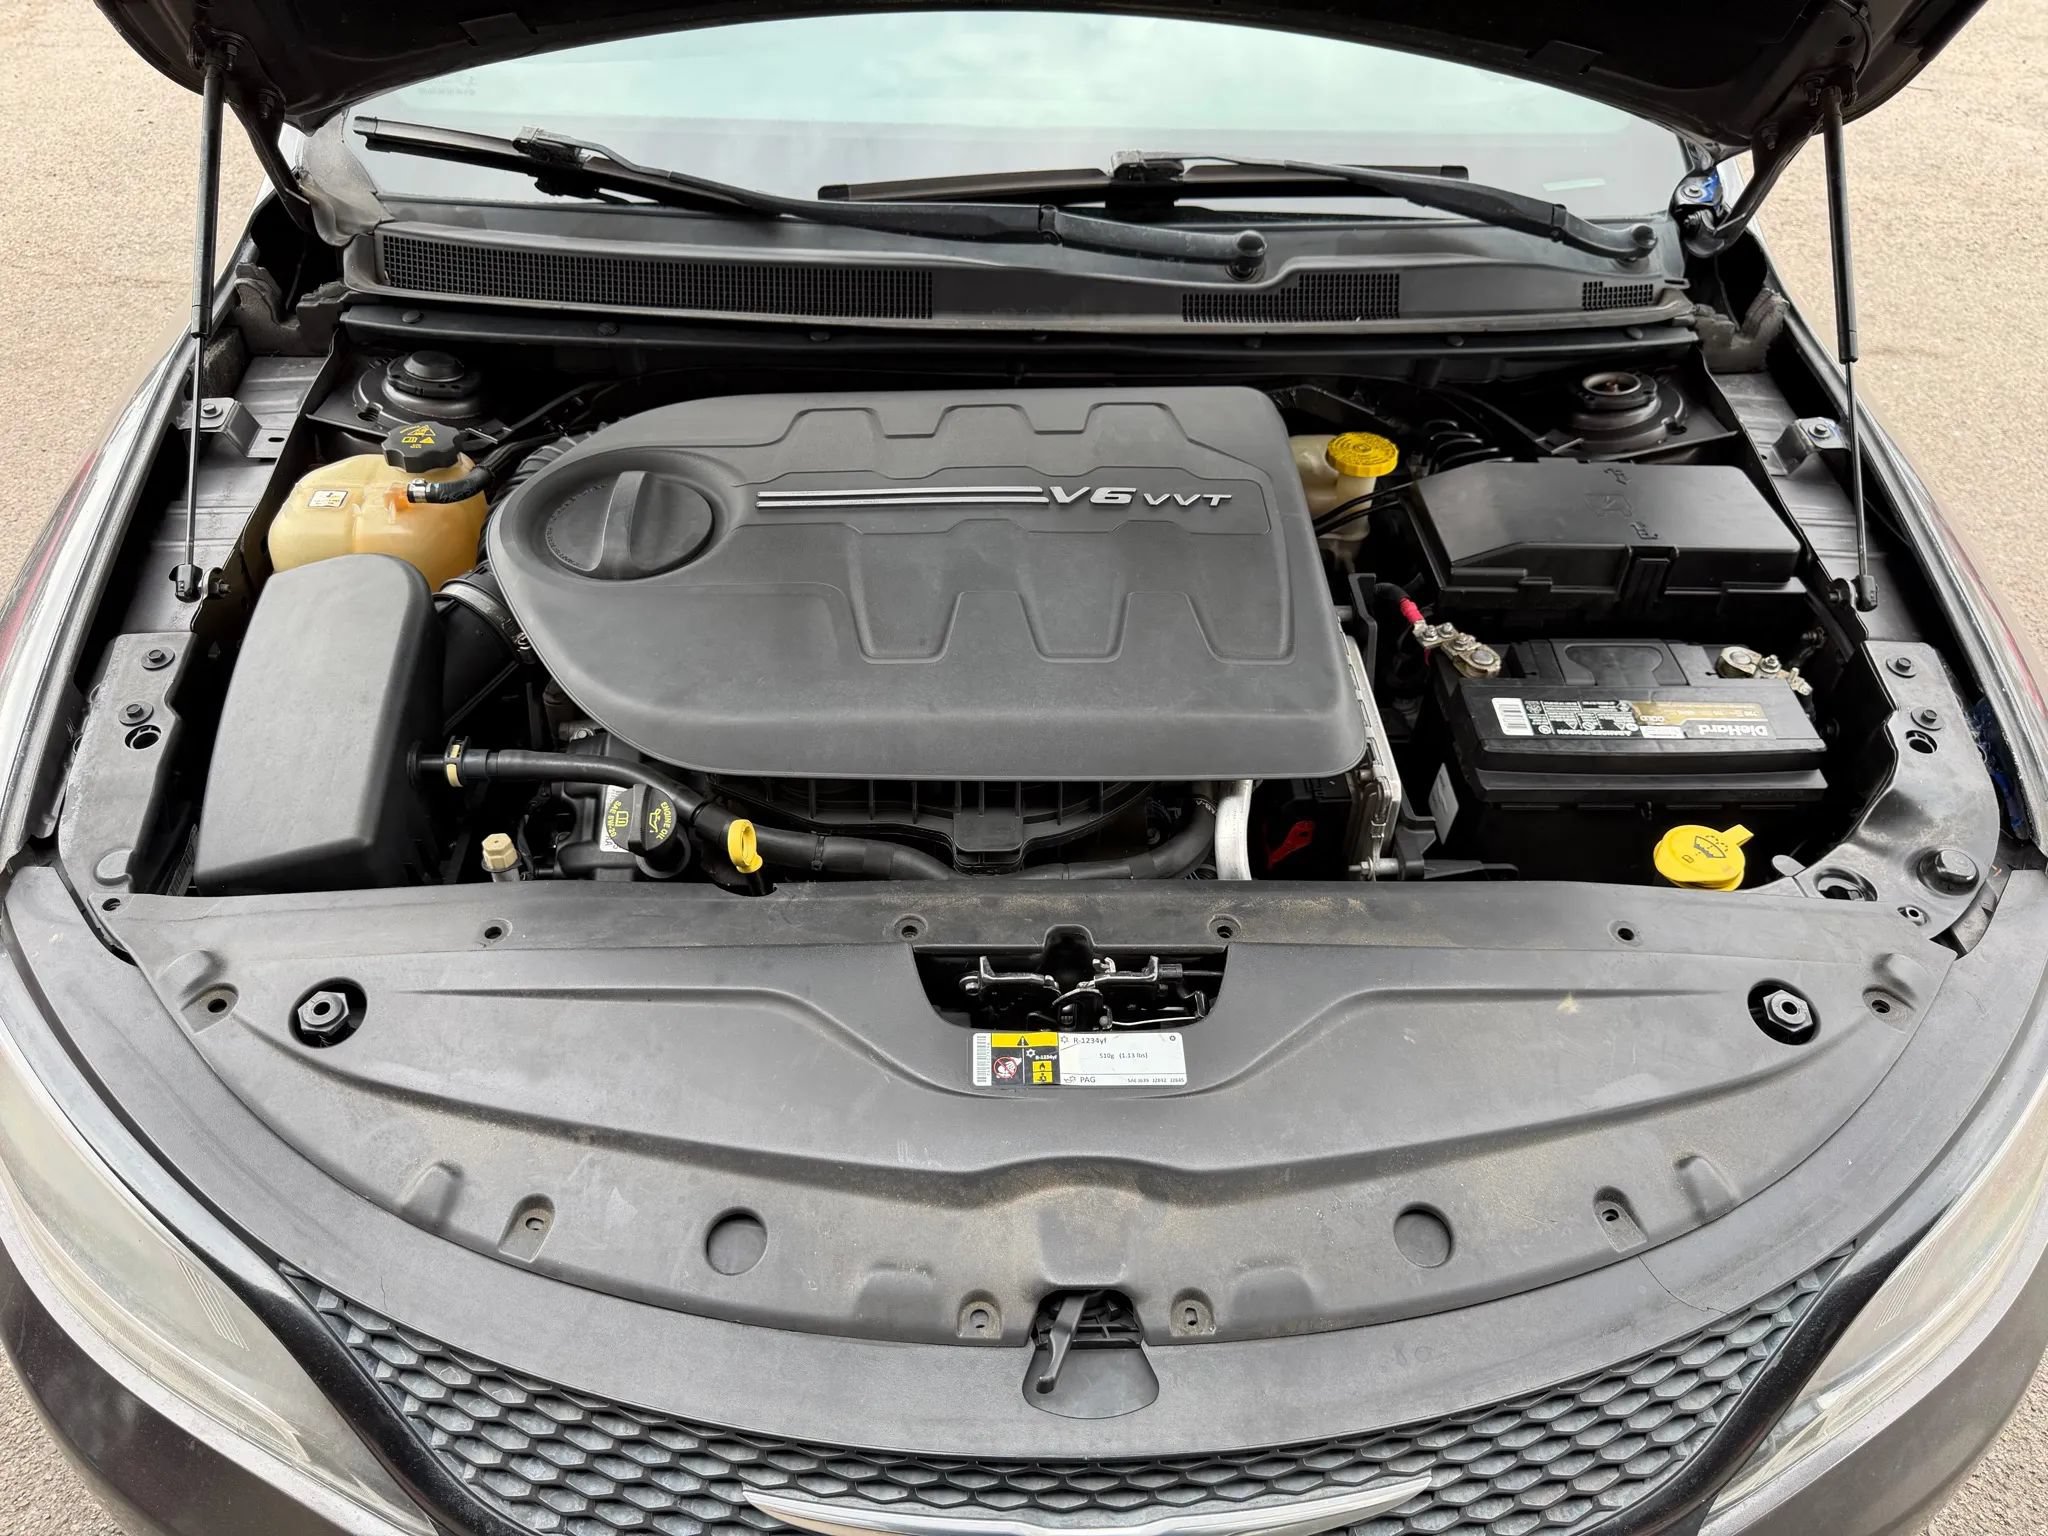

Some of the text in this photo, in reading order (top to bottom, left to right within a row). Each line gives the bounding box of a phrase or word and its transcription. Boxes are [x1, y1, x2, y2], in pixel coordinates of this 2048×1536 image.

[1048, 486, 1233, 508] V6 VVT
[1698, 724, 1769, 737] DieHard
[610, 800, 622, 814] SAE
[607, 815, 617, 837] 5W-20
[656, 801, 671, 840] ENGINE OIL
[1073, 1036, 1107, 1046] R-1234yf
